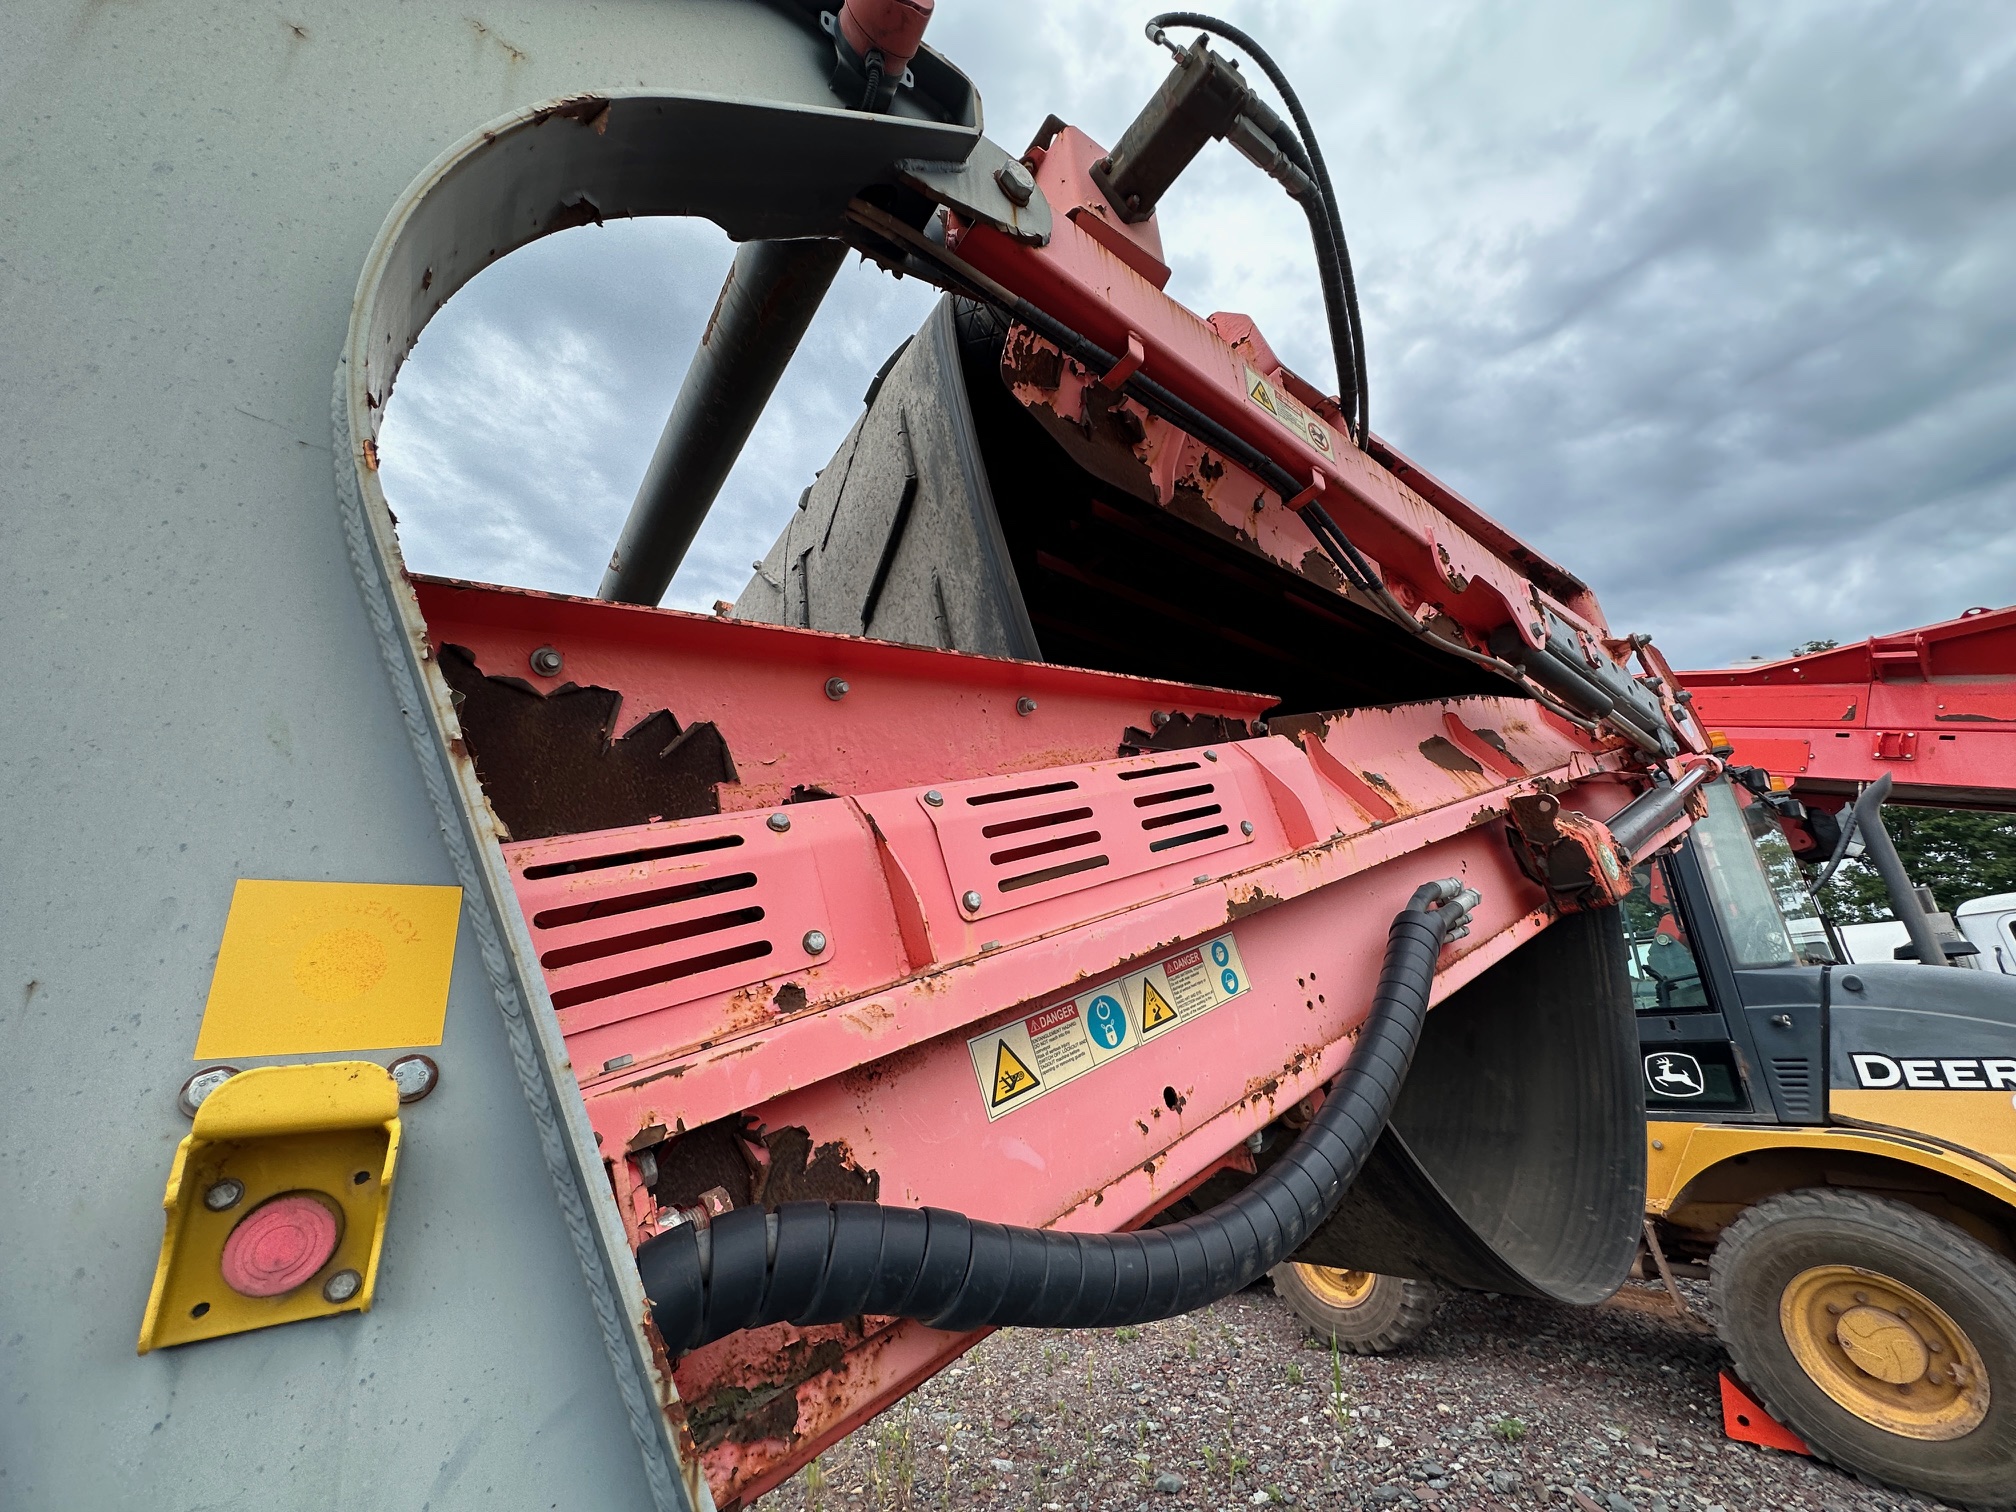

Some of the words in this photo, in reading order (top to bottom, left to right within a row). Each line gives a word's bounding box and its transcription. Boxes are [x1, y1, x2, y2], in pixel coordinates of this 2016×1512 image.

[1173, 952, 1200, 970] DANGER
[1039, 1005, 1075, 1028] DANGER
[1851, 1053, 2016, 1088] DEER
